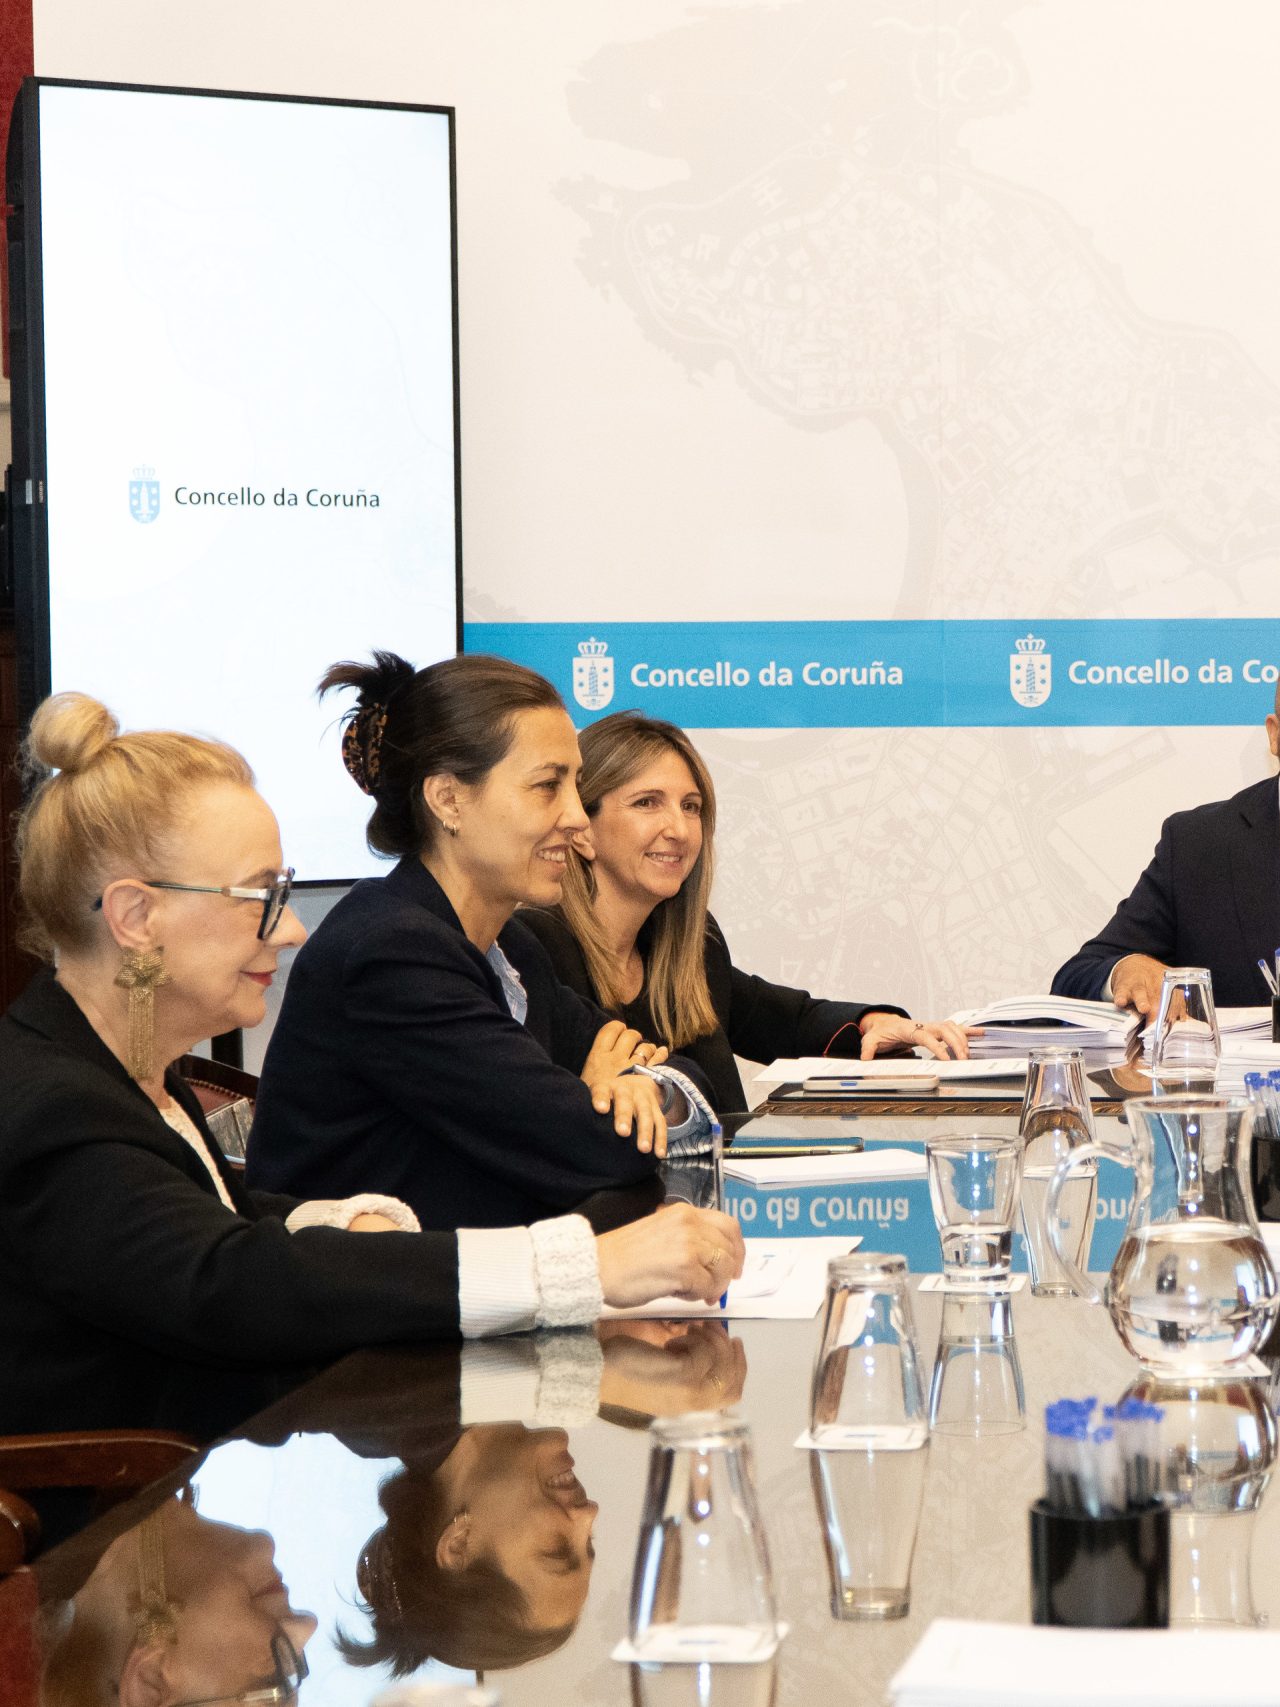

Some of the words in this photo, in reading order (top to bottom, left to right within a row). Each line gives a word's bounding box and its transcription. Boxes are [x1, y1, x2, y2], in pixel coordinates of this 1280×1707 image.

[174, 486, 266, 507] Concello
[273, 487, 299, 507] da
[305, 488, 380, 508] Coruña
[630, 661, 750, 687] Concello
[758, 660, 793, 686] da
[802, 660, 903, 686] Coruña
[1068, 658, 1190, 685] Concello
[1197, 658, 1233, 684] da
